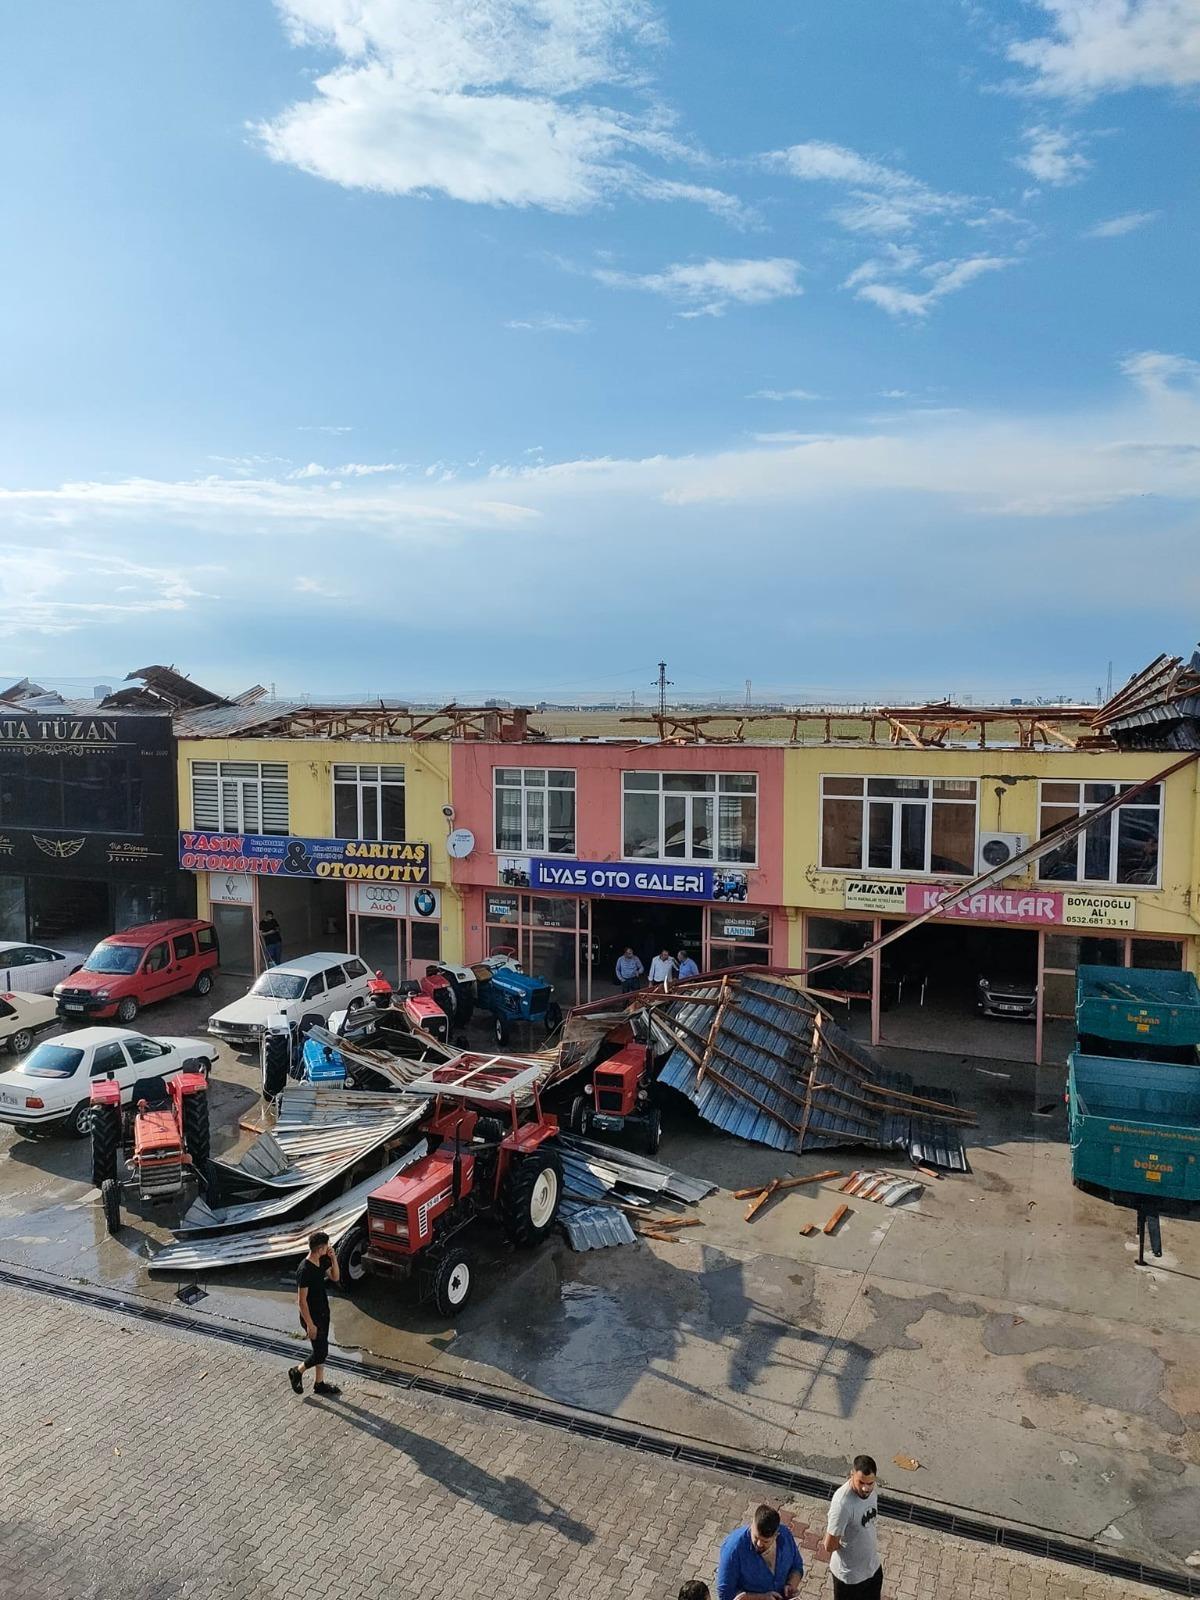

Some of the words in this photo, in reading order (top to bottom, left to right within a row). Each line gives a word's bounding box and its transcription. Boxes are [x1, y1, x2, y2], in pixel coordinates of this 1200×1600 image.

[0, 720, 31, 739] TA
[38, 717, 118, 740] TÜZAN
[182, 853, 283, 873] OTOMOTİV
[284, 841, 314, 873] &
[345, 842, 425, 864] SARITAŞ
[316, 862, 427, 882] OTOMOTİV
[539, 863, 587, 886] İLYAS
[591, 870, 630, 889] OTO
[634, 872, 704, 893] GALERİ
[848, 883, 906, 896] PAKSAN
[370, 902, 396, 912] Audi
